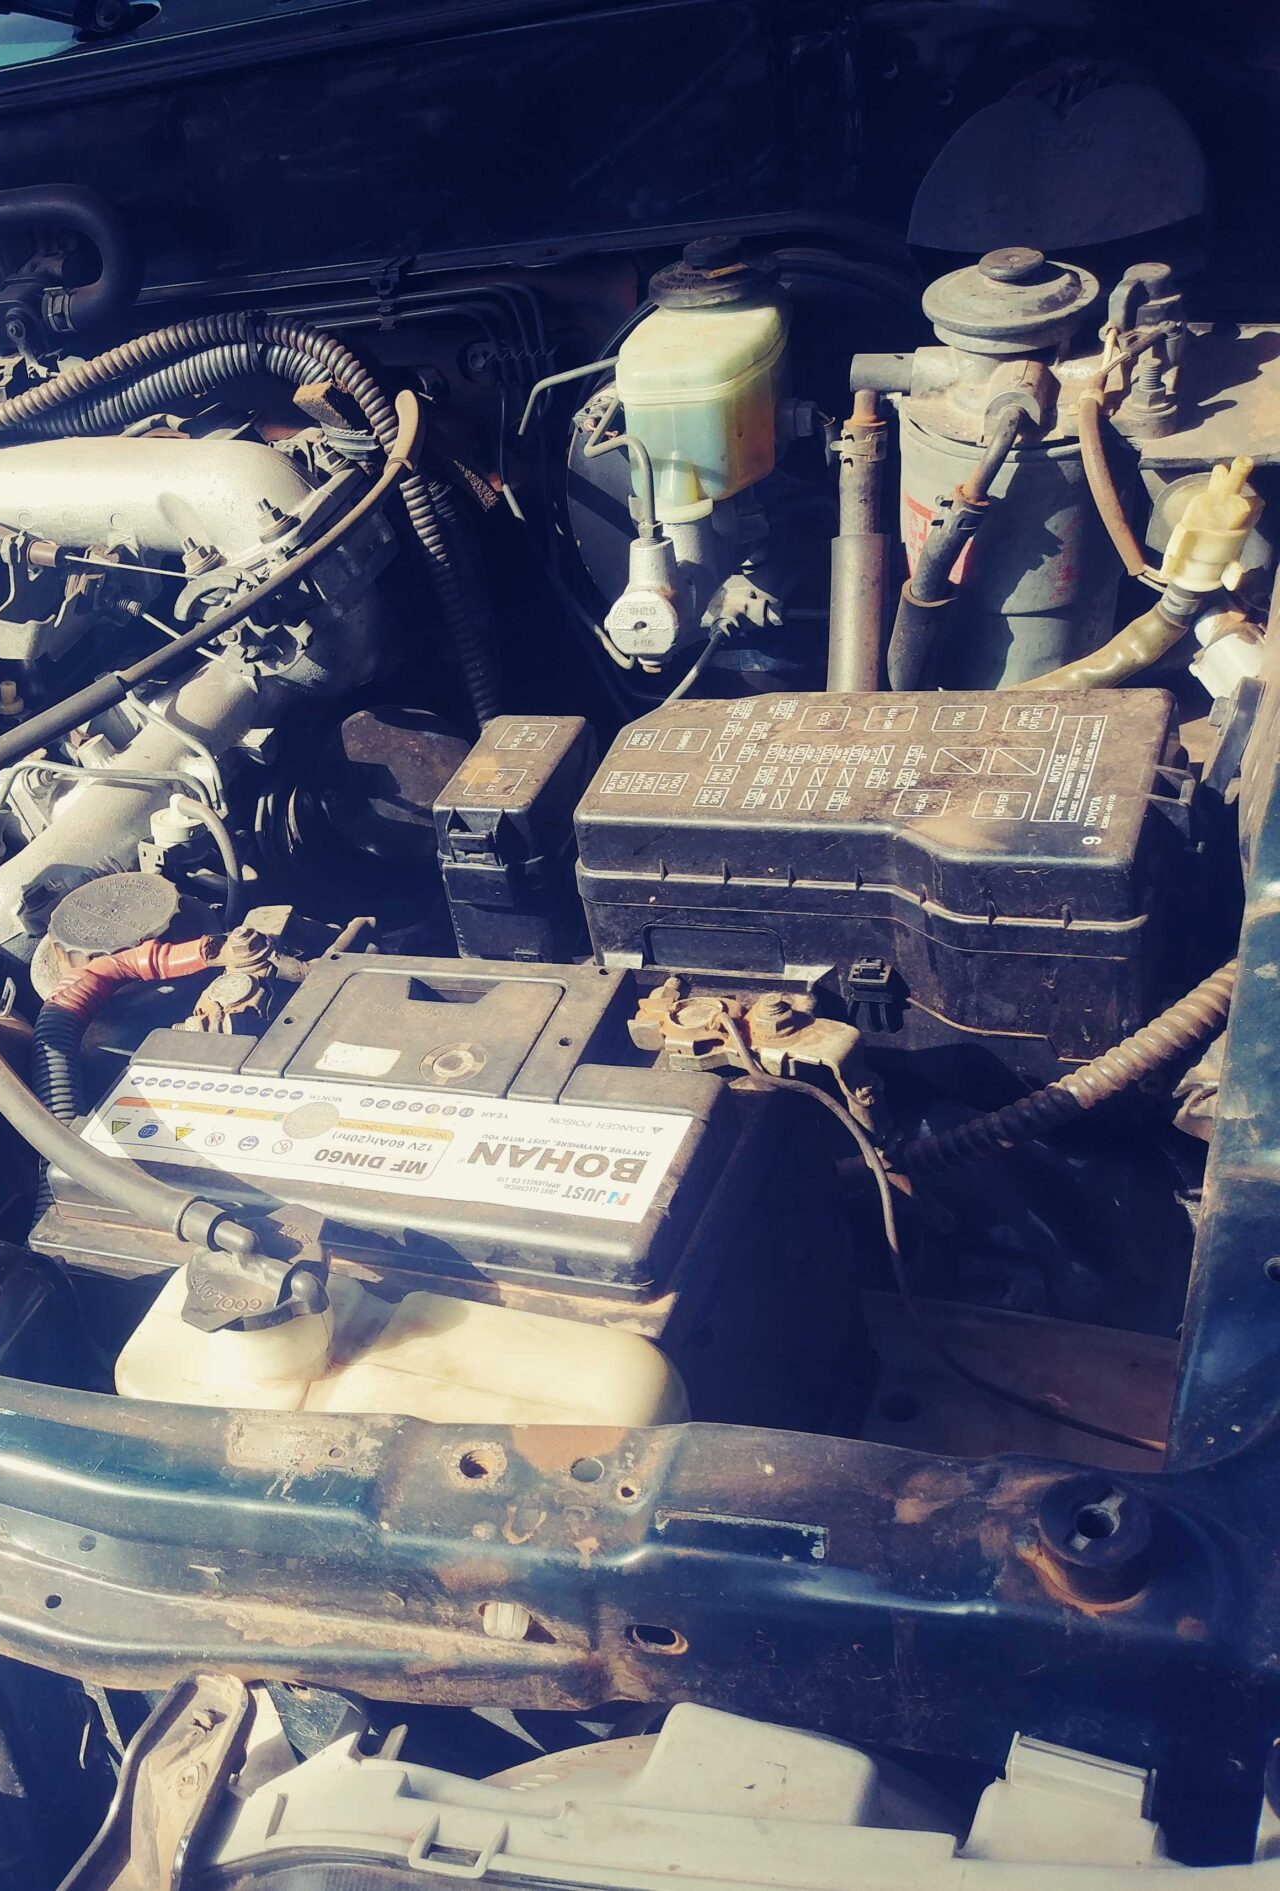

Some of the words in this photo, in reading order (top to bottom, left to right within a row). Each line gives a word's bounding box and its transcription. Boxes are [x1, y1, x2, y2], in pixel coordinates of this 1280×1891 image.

[952, 712, 966, 726] FOG
[1018, 710, 1030, 727] PWR
[1028, 708, 1044, 729] OUTLET
[630, 732, 643, 745] ABS
[711, 768, 723, 781] AM1
[721, 768, 735, 781] 50A
[1048, 754, 1067, 783] NOTICE
[604, 772, 621, 793] HEATER
[630, 773, 647, 793] GLOW
[658, 778, 672, 791] ALT
[668, 776, 684, 793] 100A
[896, 770, 912, 787] 20A
[698, 789, 713, 805] AM2
[710, 790, 723, 805] 30A
[914, 794, 929, 814] HEAD
[994, 794, 1009, 816] HEATER
[1083, 796, 1104, 828] TOYOTA
[1081, 836, 1102, 845] 9
[309, 1095, 344, 1104] MONTH
[481, 1111, 508, 1119] YEAR
[548, 1117, 592, 1128] POISON
[337, 1120, 384, 1132] CONDITION
[597, 1122, 646, 1133] DANGER
[332, 1132, 406, 1150] 60Ah(20hr)
[410, 1142, 433, 1152] 12V
[502, 1136, 528, 1144] WITH
[530, 1139, 551, 1147] JUST
[609, 1146, 652, 1157] ANYTIME
[314, 1149, 386, 1170] DIN60
[467, 1142, 648, 1184] BOHAN
[390, 1160, 429, 1175] MF
[541, 1188, 558, 1196] JUST
[561, 1184, 607, 1203] JUST
[191, 1274, 262, 1312] COOLANT
